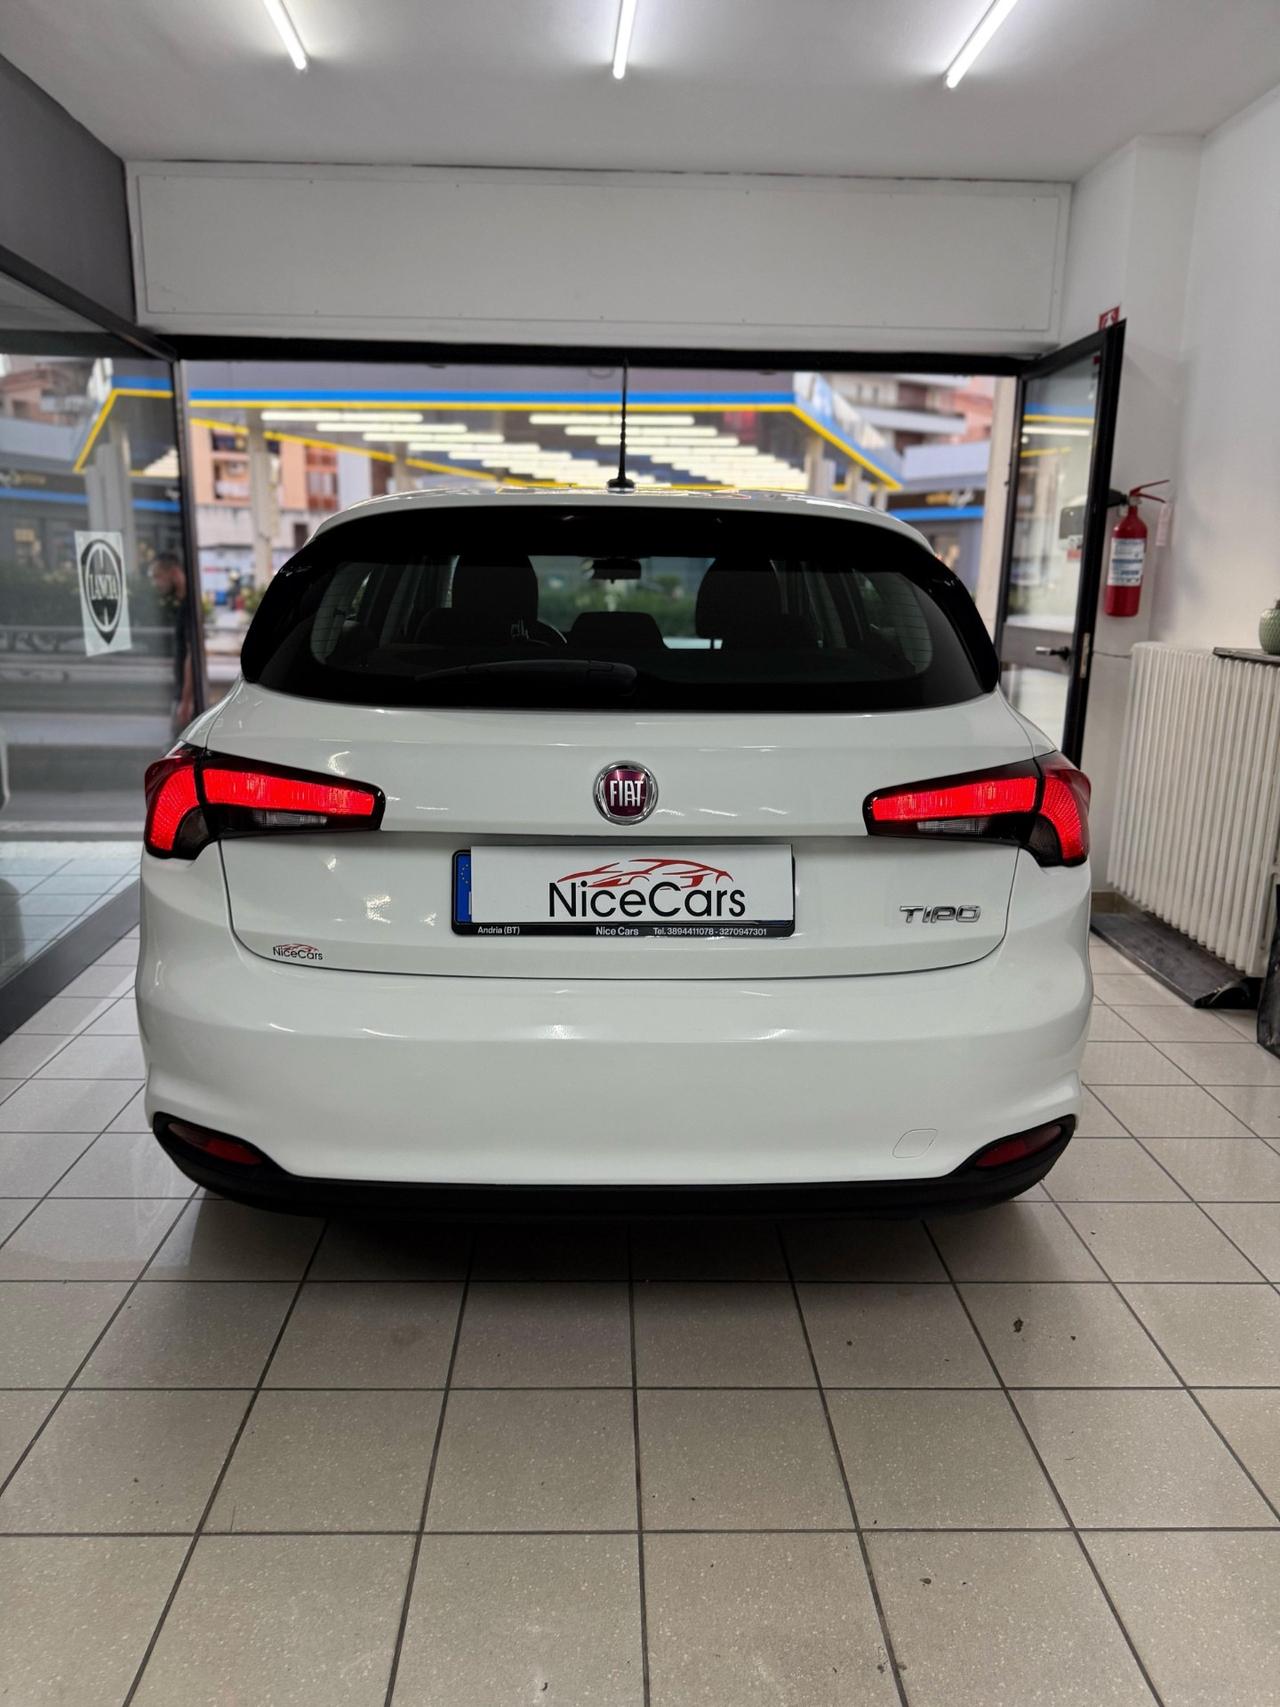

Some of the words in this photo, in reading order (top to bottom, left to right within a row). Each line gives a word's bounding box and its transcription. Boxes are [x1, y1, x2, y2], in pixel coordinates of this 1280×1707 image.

[609, 780, 644, 807] FIAT
[549, 880, 746, 918] NiceCars
[900, 905, 981, 923] TIPO
[477, 926, 503, 935] Andria
[503, 926, 521, 935] (BT)
[595, 926, 617, 936] Nice
[617, 926, 639, 936] Cars
[719, 928, 767, 936] 3270947301
[272, 946, 323, 960] NiceCars
